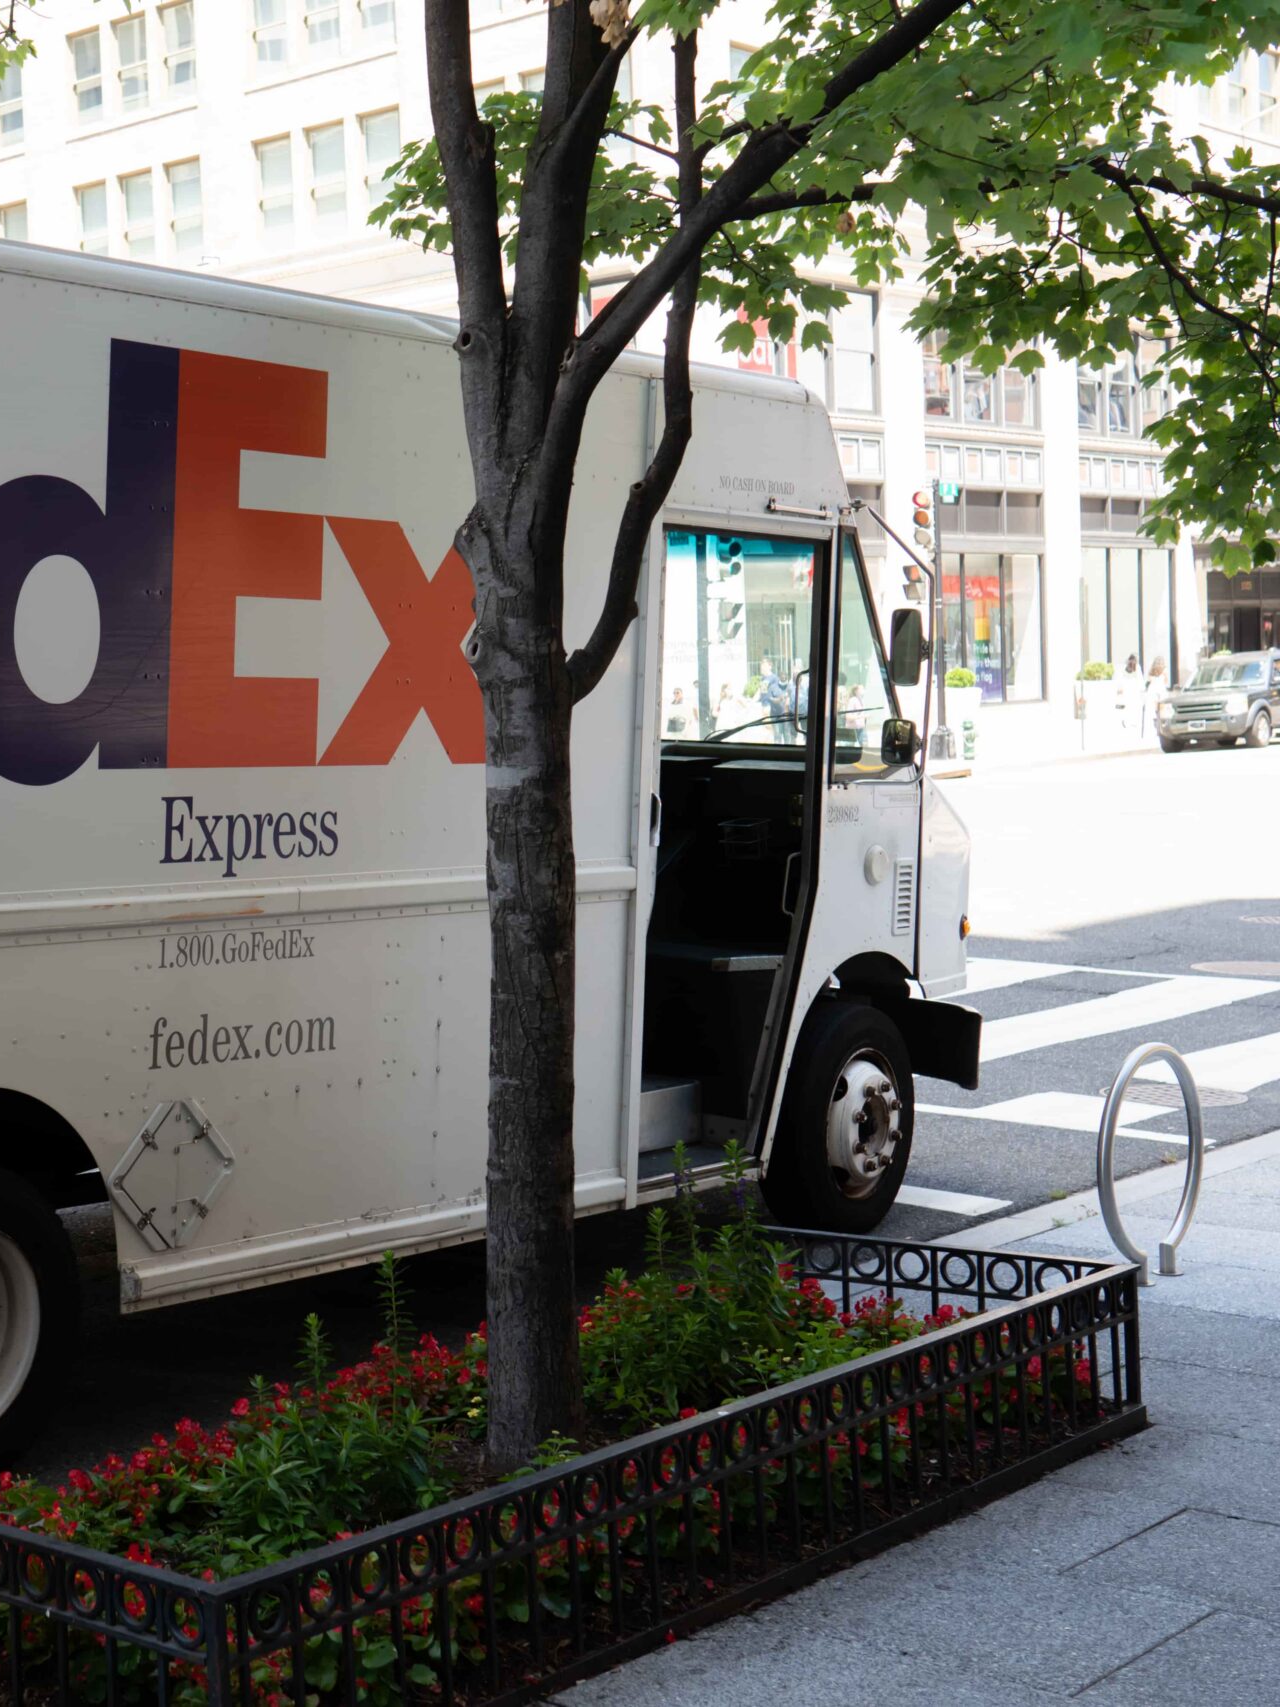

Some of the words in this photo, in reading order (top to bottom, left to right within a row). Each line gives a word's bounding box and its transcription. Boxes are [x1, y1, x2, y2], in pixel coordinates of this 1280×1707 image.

[720, 475, 731, 489] NO
[732, 477, 754, 492] CASH
[755, 478, 766, 492] ON
[768, 480, 795, 495] BOARD
[159, 796, 339, 877] Express
[158, 929, 315, 969] 1.800.GoFedEx
[148, 1013, 337, 1070] fedex.com
